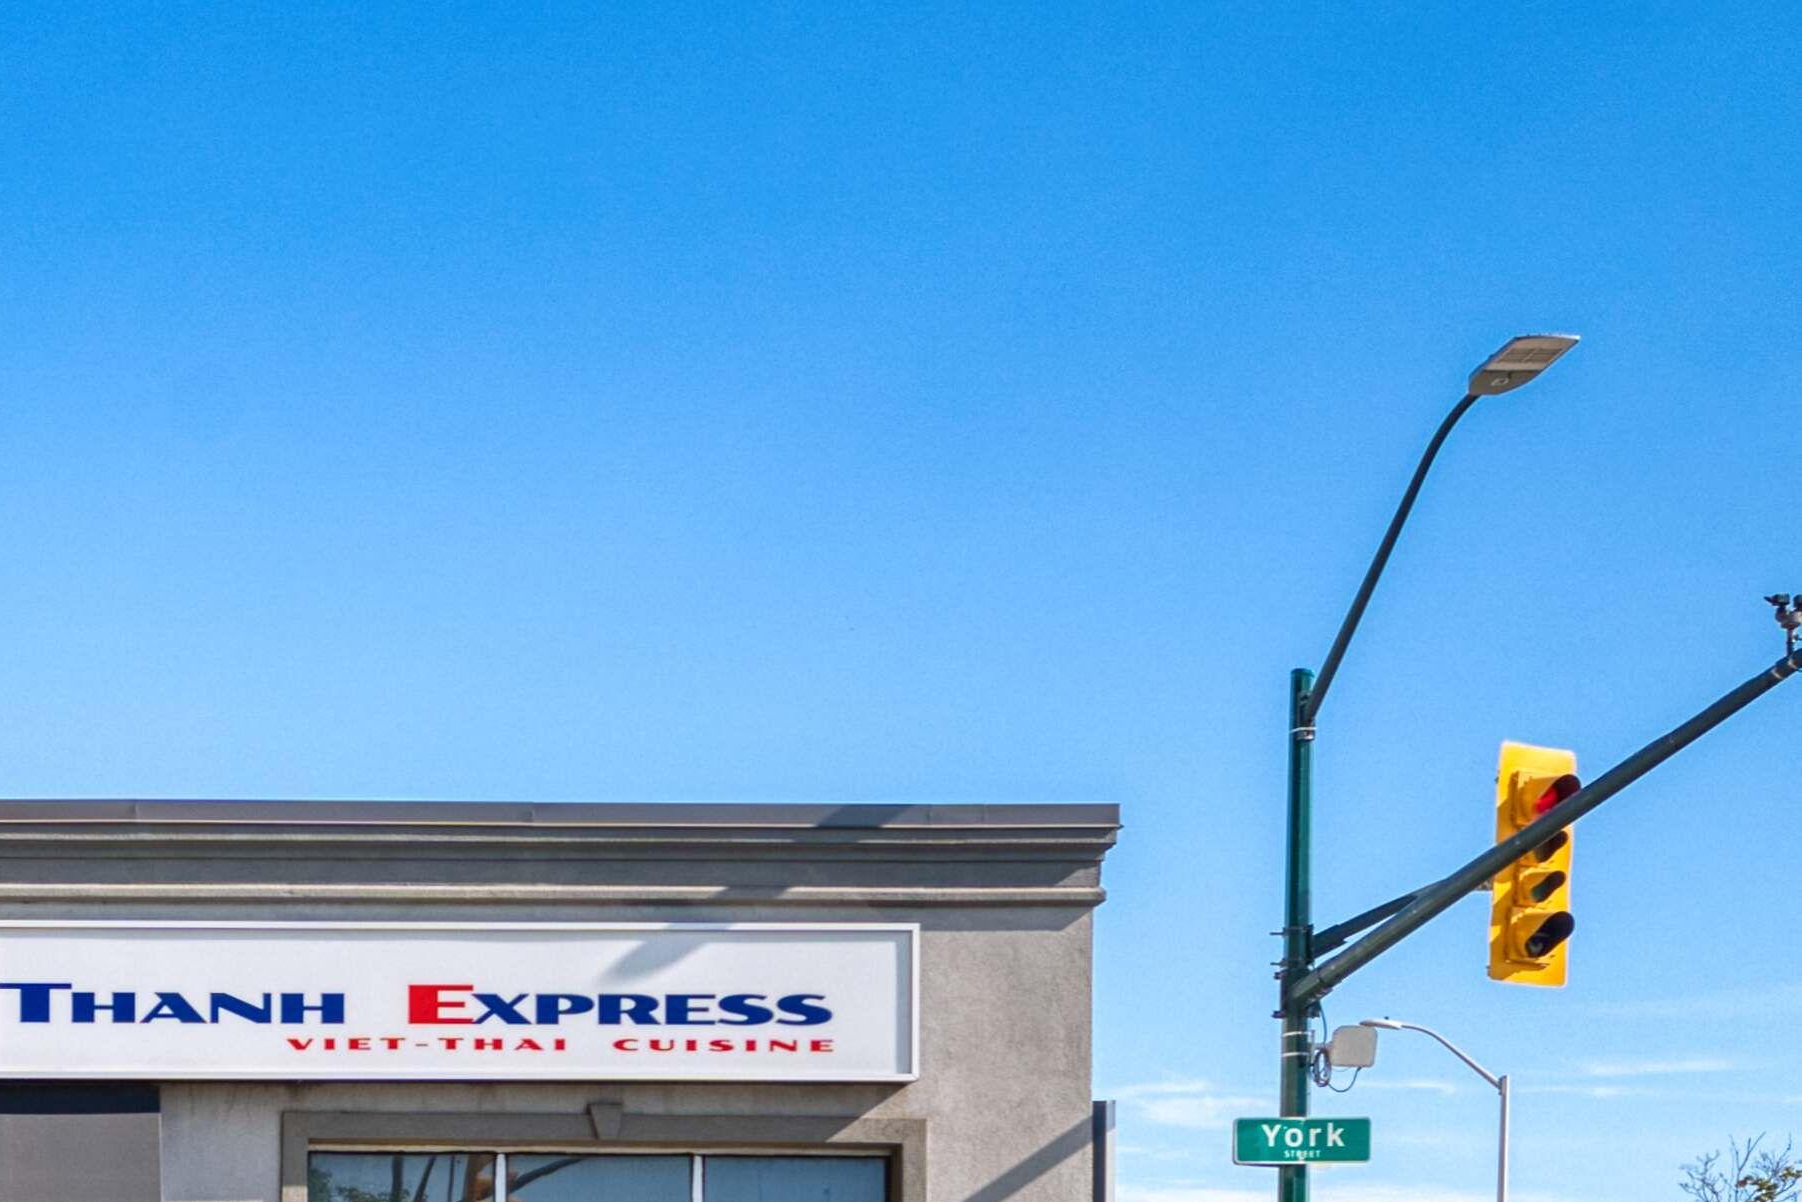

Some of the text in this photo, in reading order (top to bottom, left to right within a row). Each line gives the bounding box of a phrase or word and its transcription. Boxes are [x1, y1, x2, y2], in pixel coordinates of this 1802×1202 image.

[407, 984, 834, 1026] EXPRESS
[286, 1037, 836, 1053] VIET-THAI CUISINE
[1261, 1122, 1346, 1148] York
[1284, 1149, 1322, 1159] STREET
